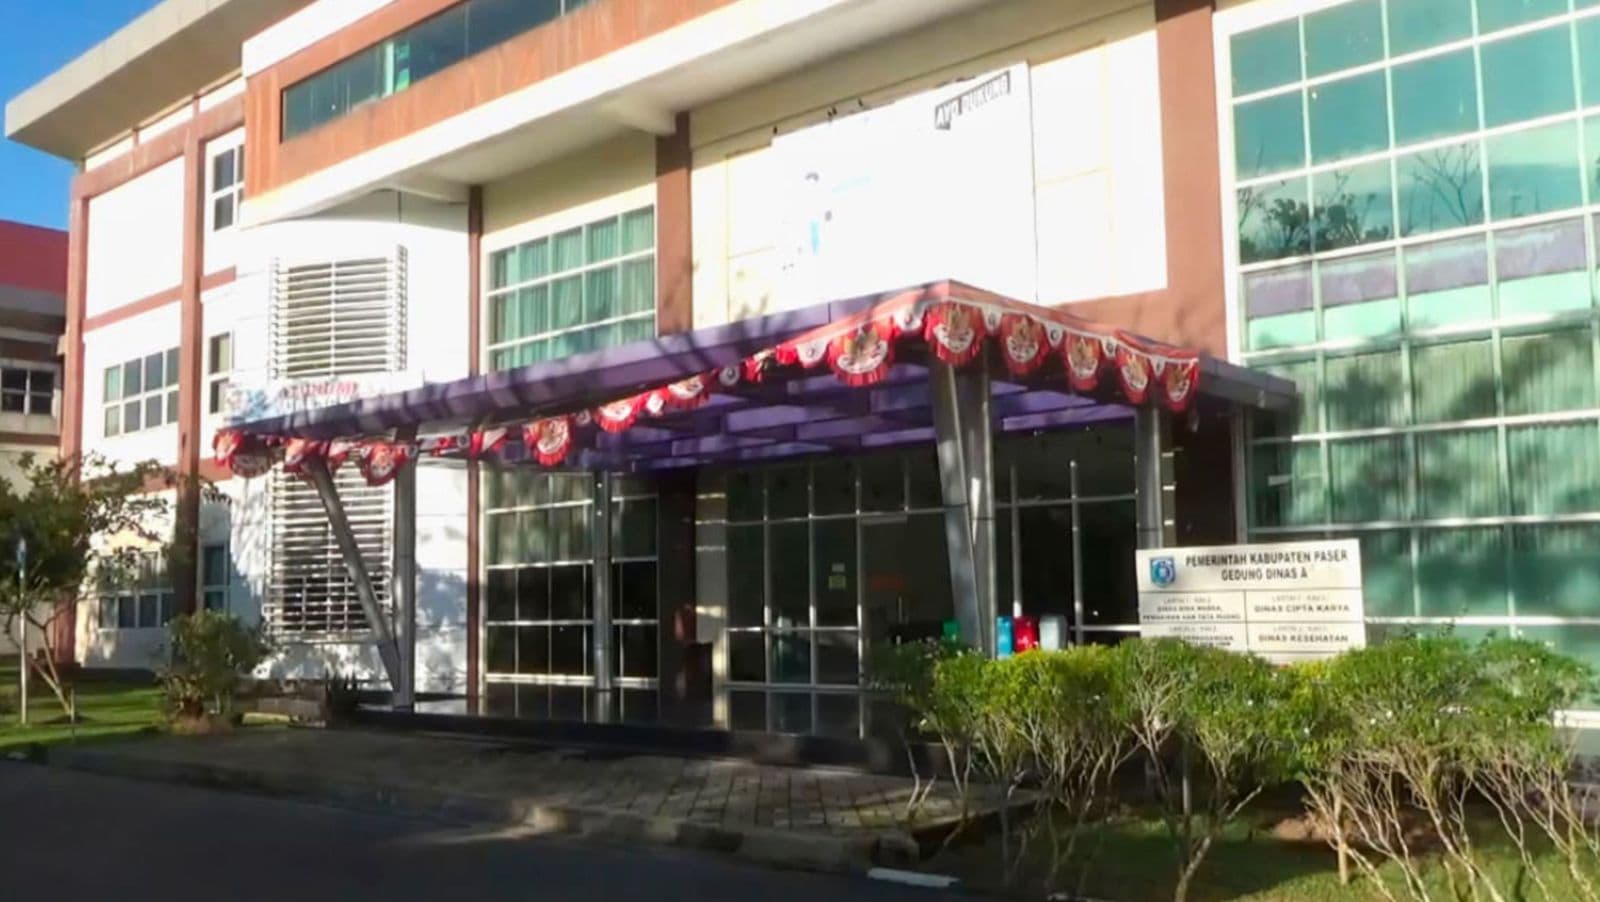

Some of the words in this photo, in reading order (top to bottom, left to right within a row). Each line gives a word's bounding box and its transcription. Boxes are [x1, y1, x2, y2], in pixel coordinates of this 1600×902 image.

[1186, 553, 1247, 567] PEMERINTAH
[1249, 551, 1311, 565] KABUPATEN
[1314, 549, 1347, 562] PASER
[1221, 568, 1262, 581] GEDUNG
[1266, 567, 1297, 580] DINAS
[1300, 566, 1308, 578] A
[1254, 604, 1283, 613] DINAS
[1286, 604, 1313, 613] CIPTA
[1316, 603, 1349, 612] KARYA
[1258, 634, 1287, 643] DINAS
[1290, 634, 1349, 643] KESEHATAN
